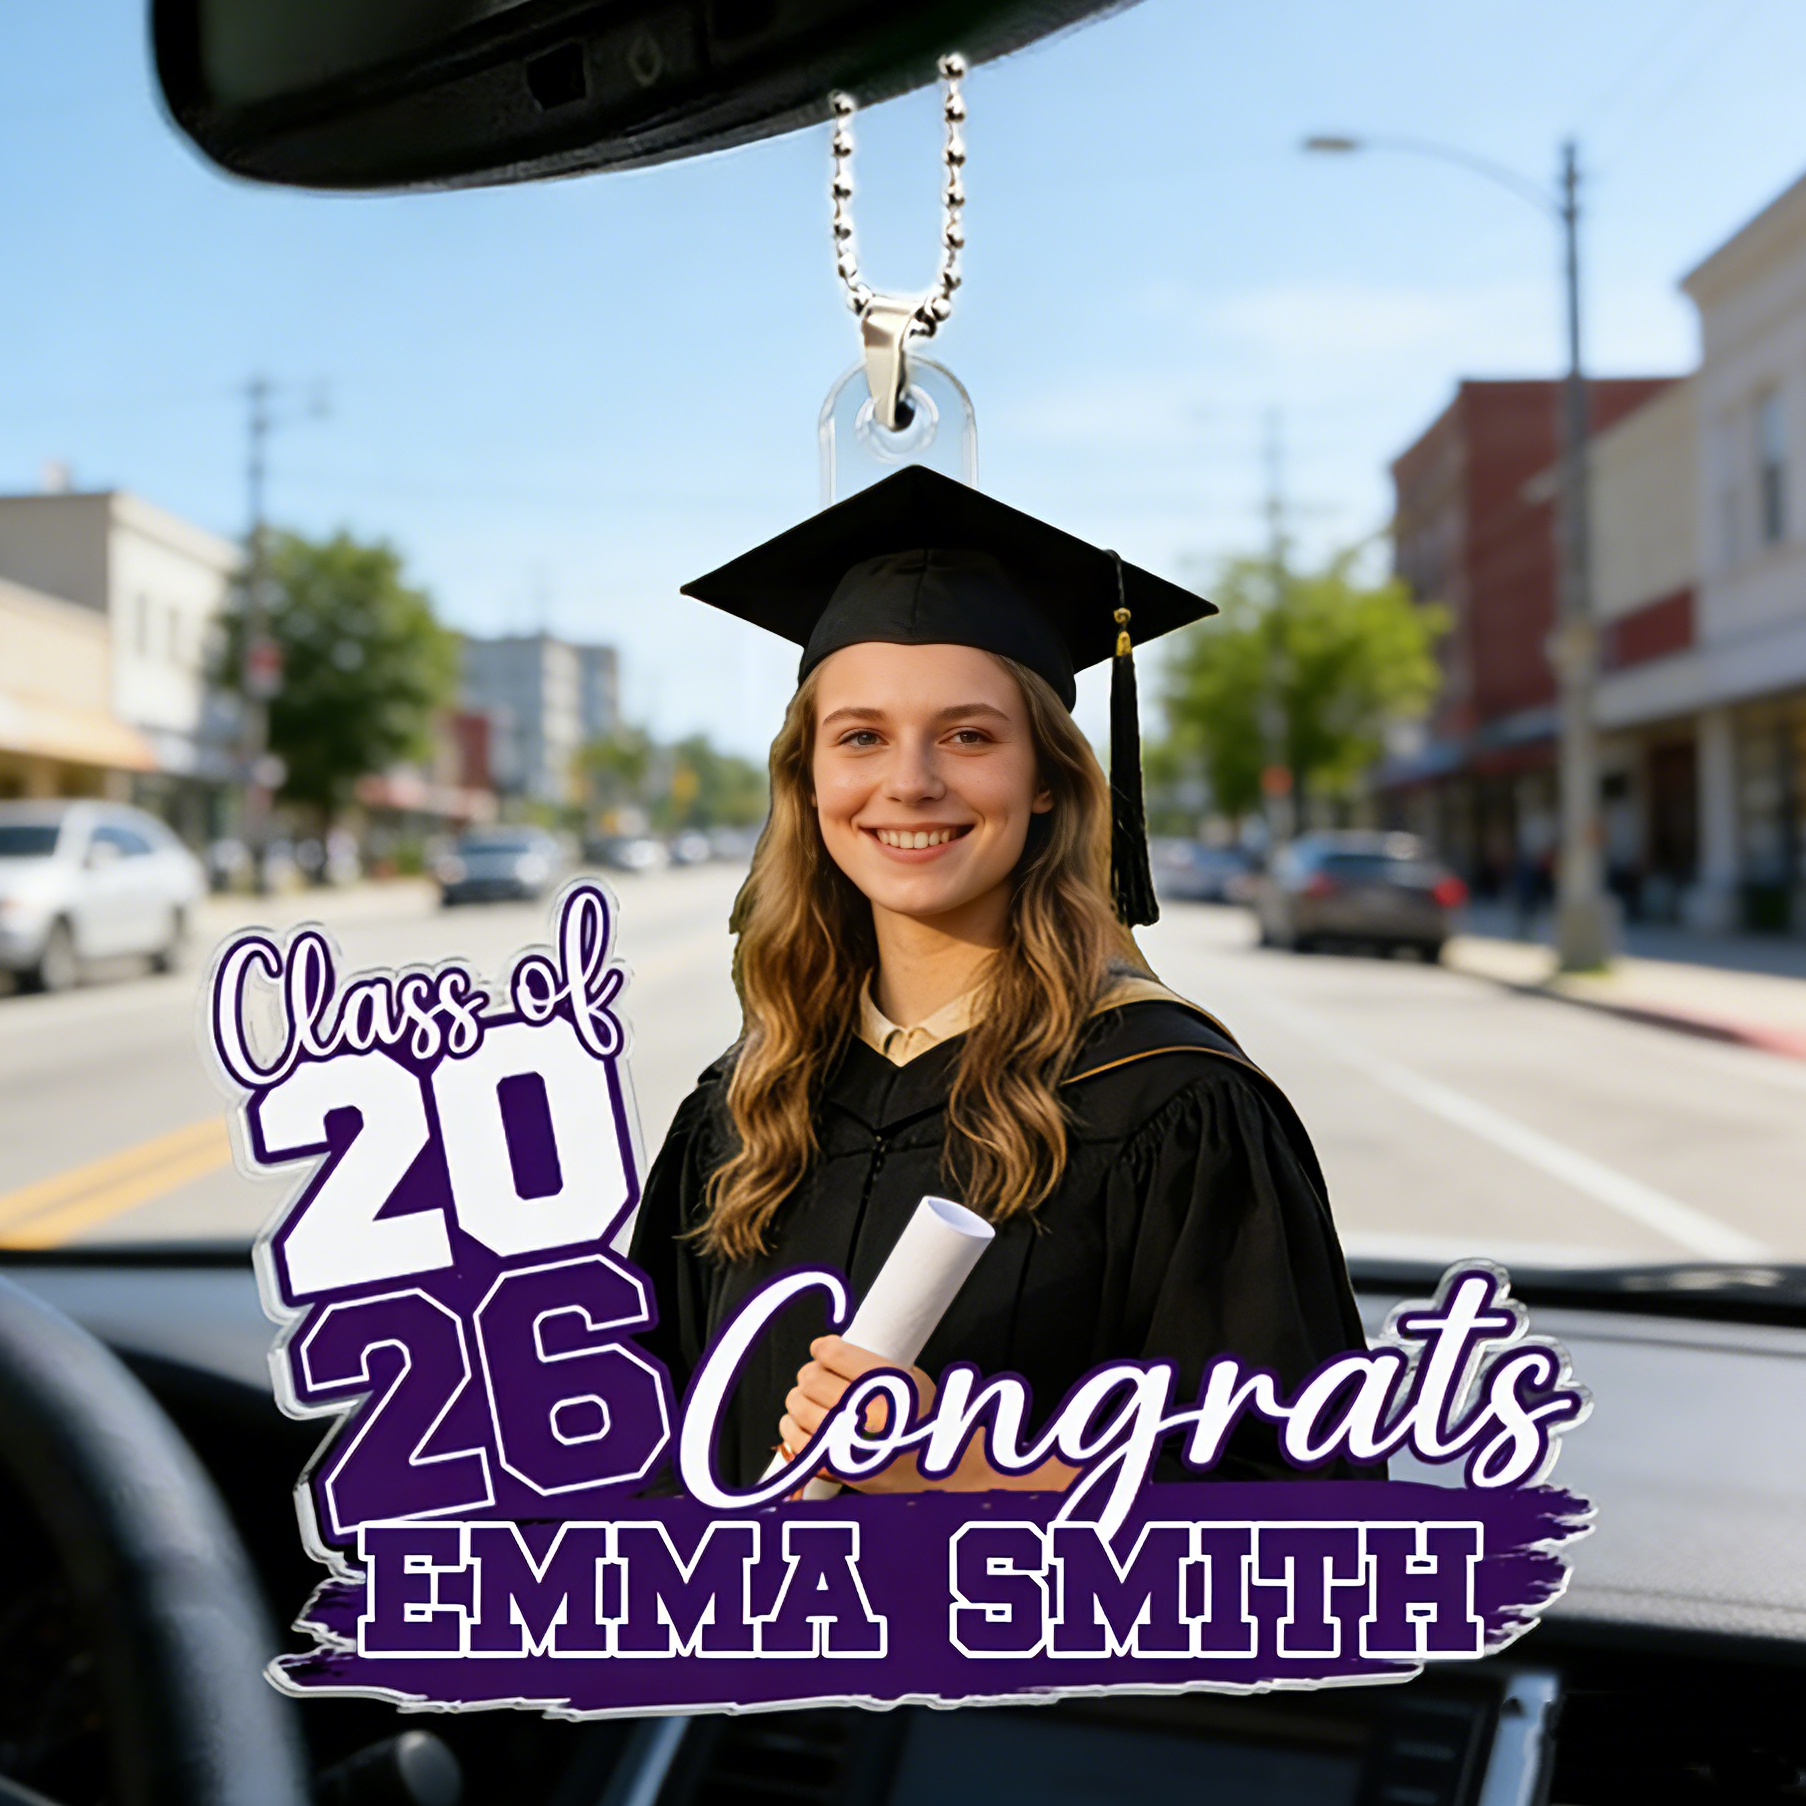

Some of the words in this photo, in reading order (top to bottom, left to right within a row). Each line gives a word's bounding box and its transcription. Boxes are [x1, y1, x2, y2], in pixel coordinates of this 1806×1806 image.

[215, 933, 488, 1087] Class
[513, 887, 623, 1060] of
[259, 1017, 629, 1296] 20
[301, 1255, 671, 1536] 26
[680, 1271, 1573, 1540] Congrats
[358, 1520, 888, 1659] EMMA
[949, 1520, 1485, 1660] SMITH
